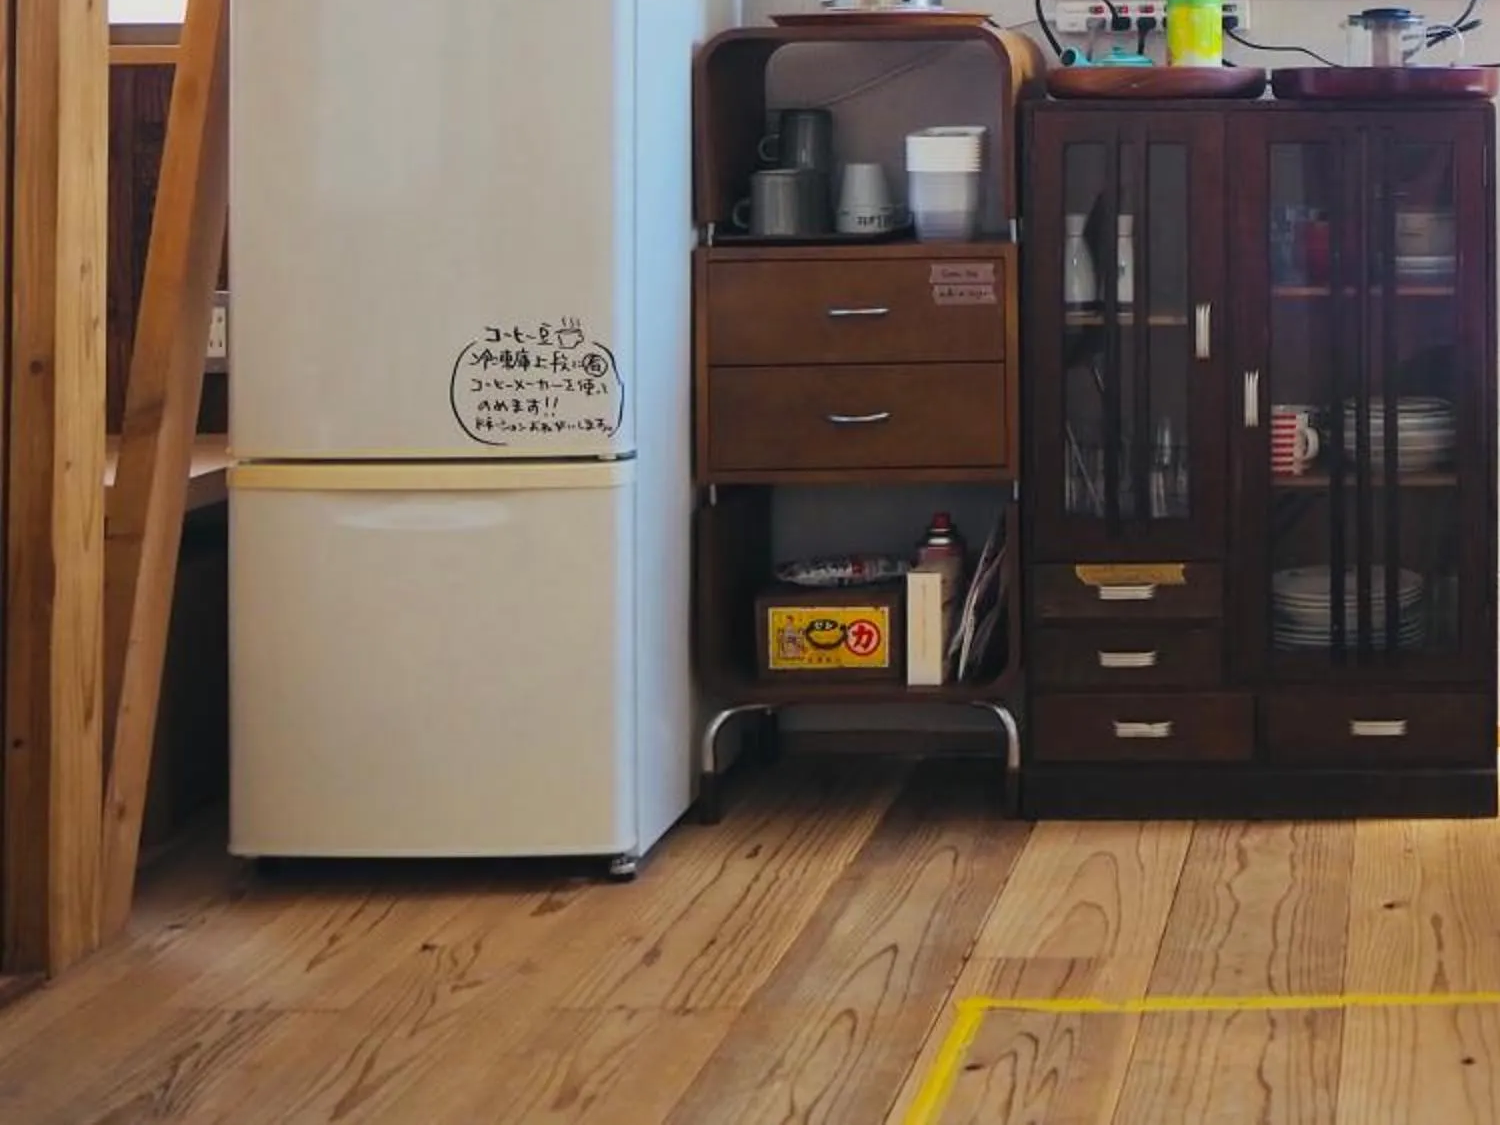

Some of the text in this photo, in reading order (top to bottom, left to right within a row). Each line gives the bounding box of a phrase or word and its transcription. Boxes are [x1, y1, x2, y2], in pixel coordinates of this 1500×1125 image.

[484, 322, 554, 347] コーヒー豆
